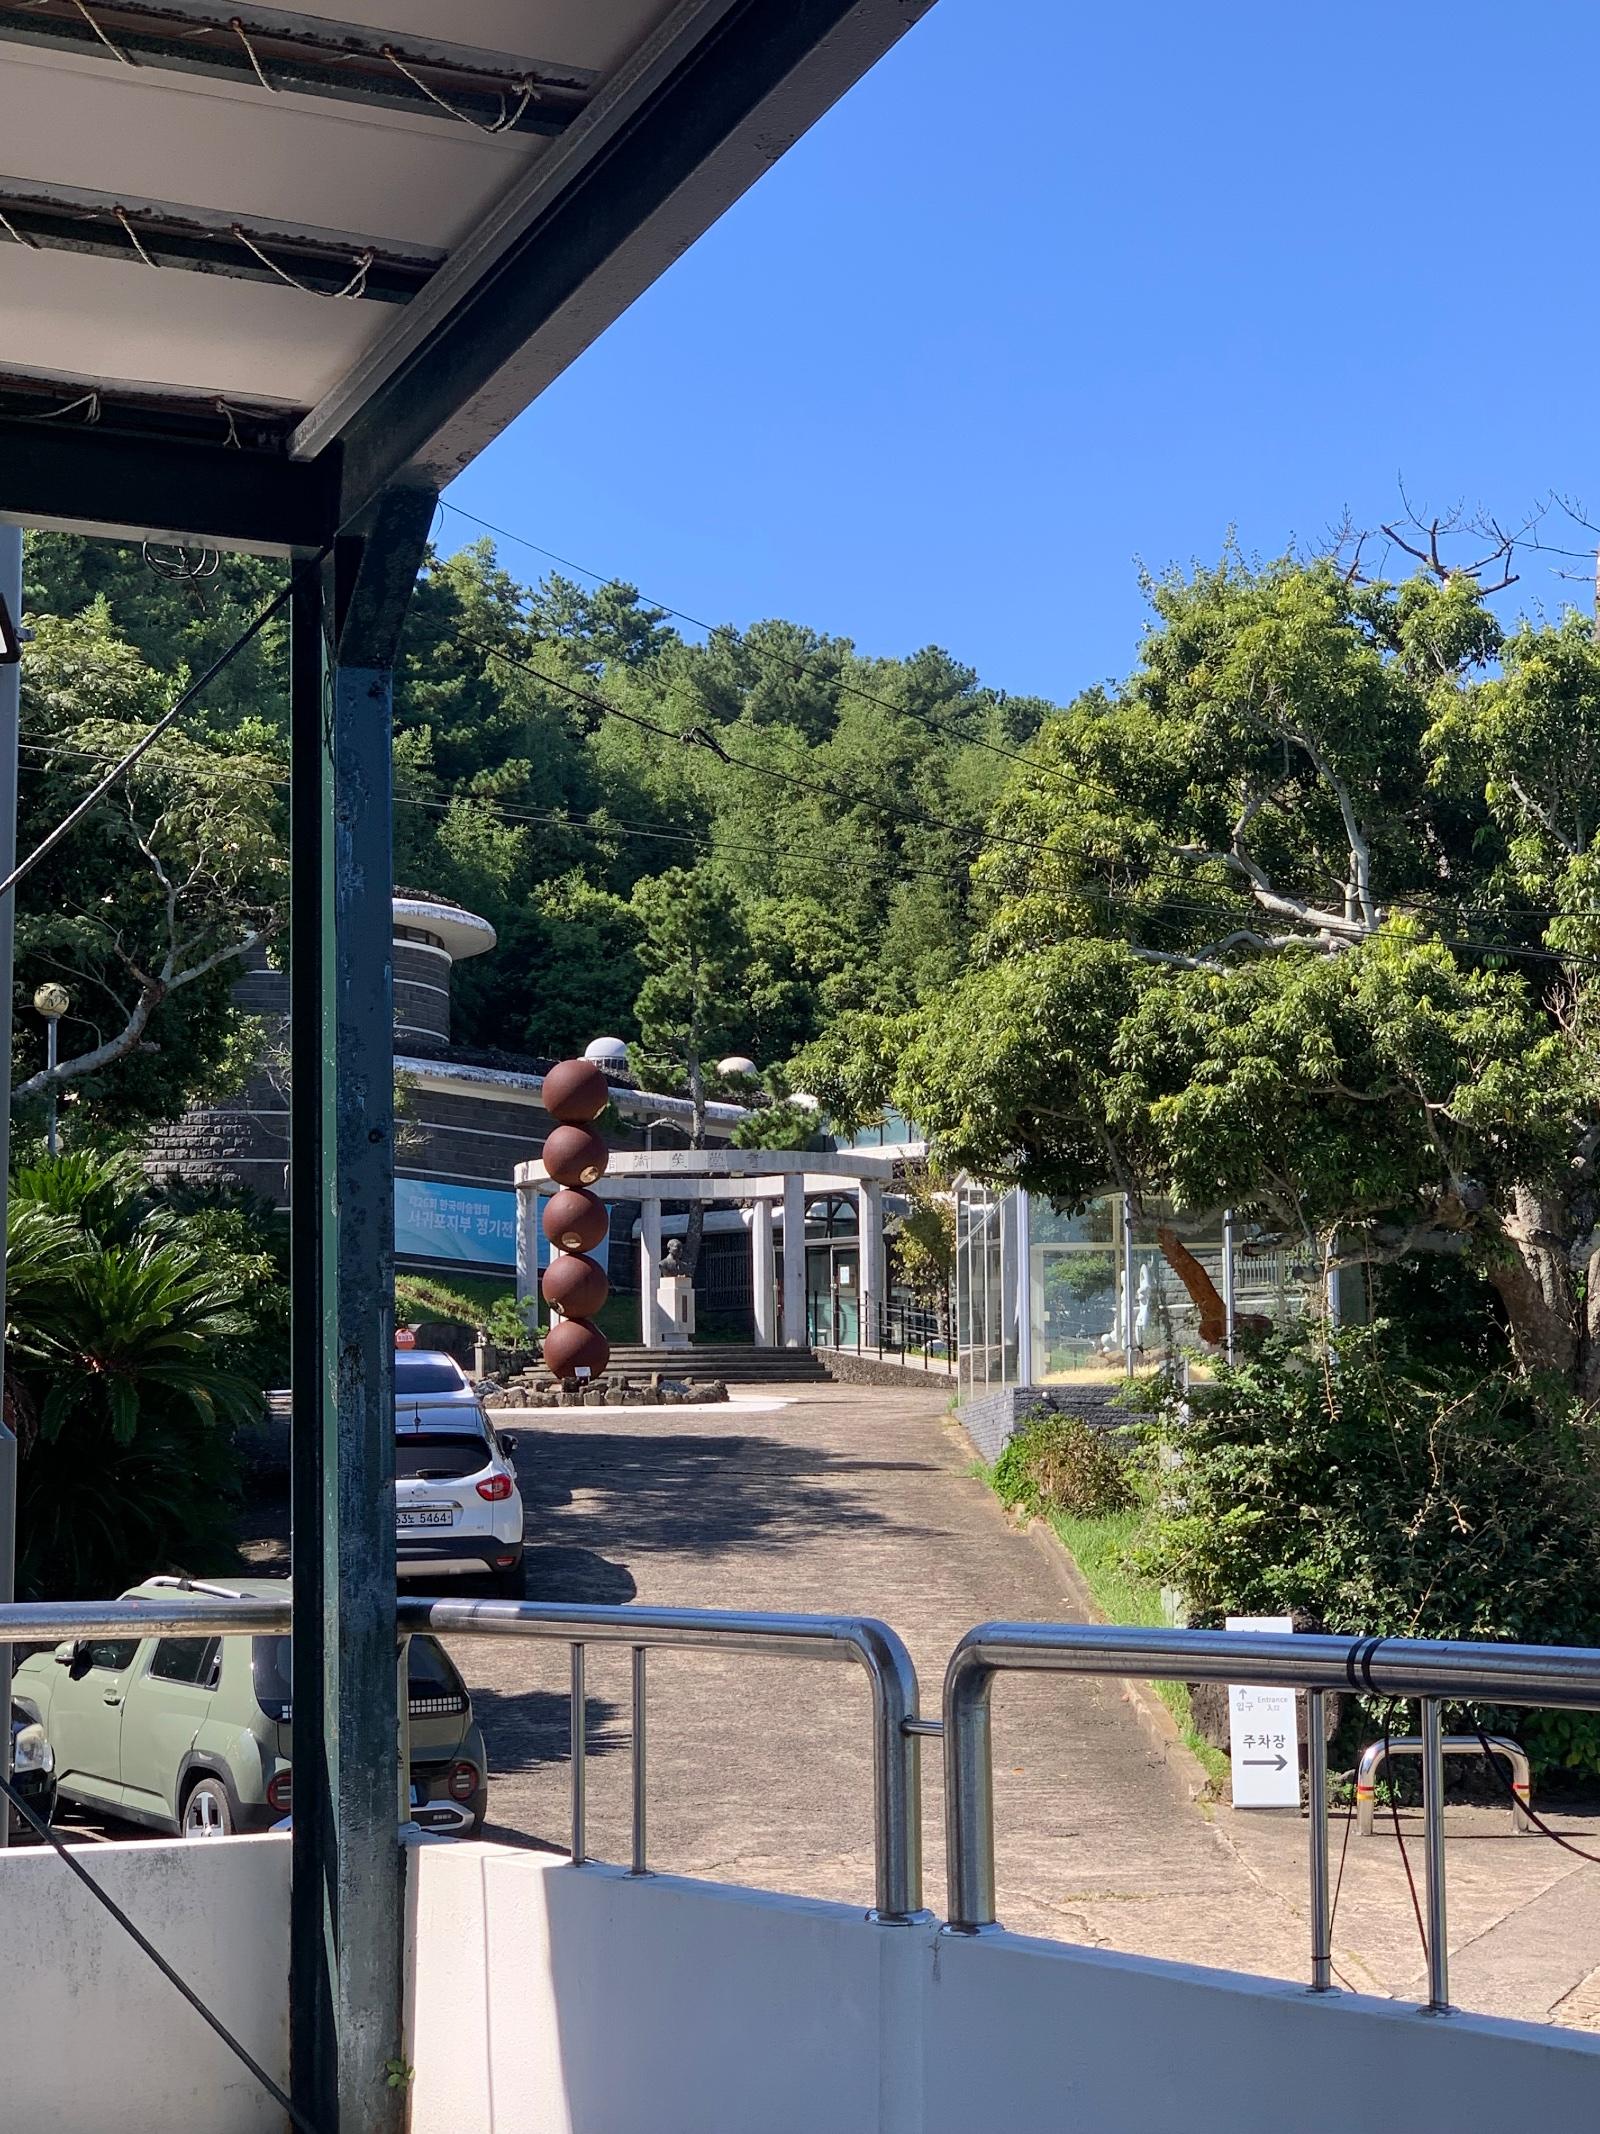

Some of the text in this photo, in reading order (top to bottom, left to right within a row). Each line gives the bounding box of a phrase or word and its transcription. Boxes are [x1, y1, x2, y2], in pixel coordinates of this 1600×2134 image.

[408, 1210, 513, 1239] 서귀포지부 정기전
[420, 1513, 446, 1523] 5464
[1236, 1702, 1254, 1712] 입구
[1243, 1734, 1286, 1749] 주차장
